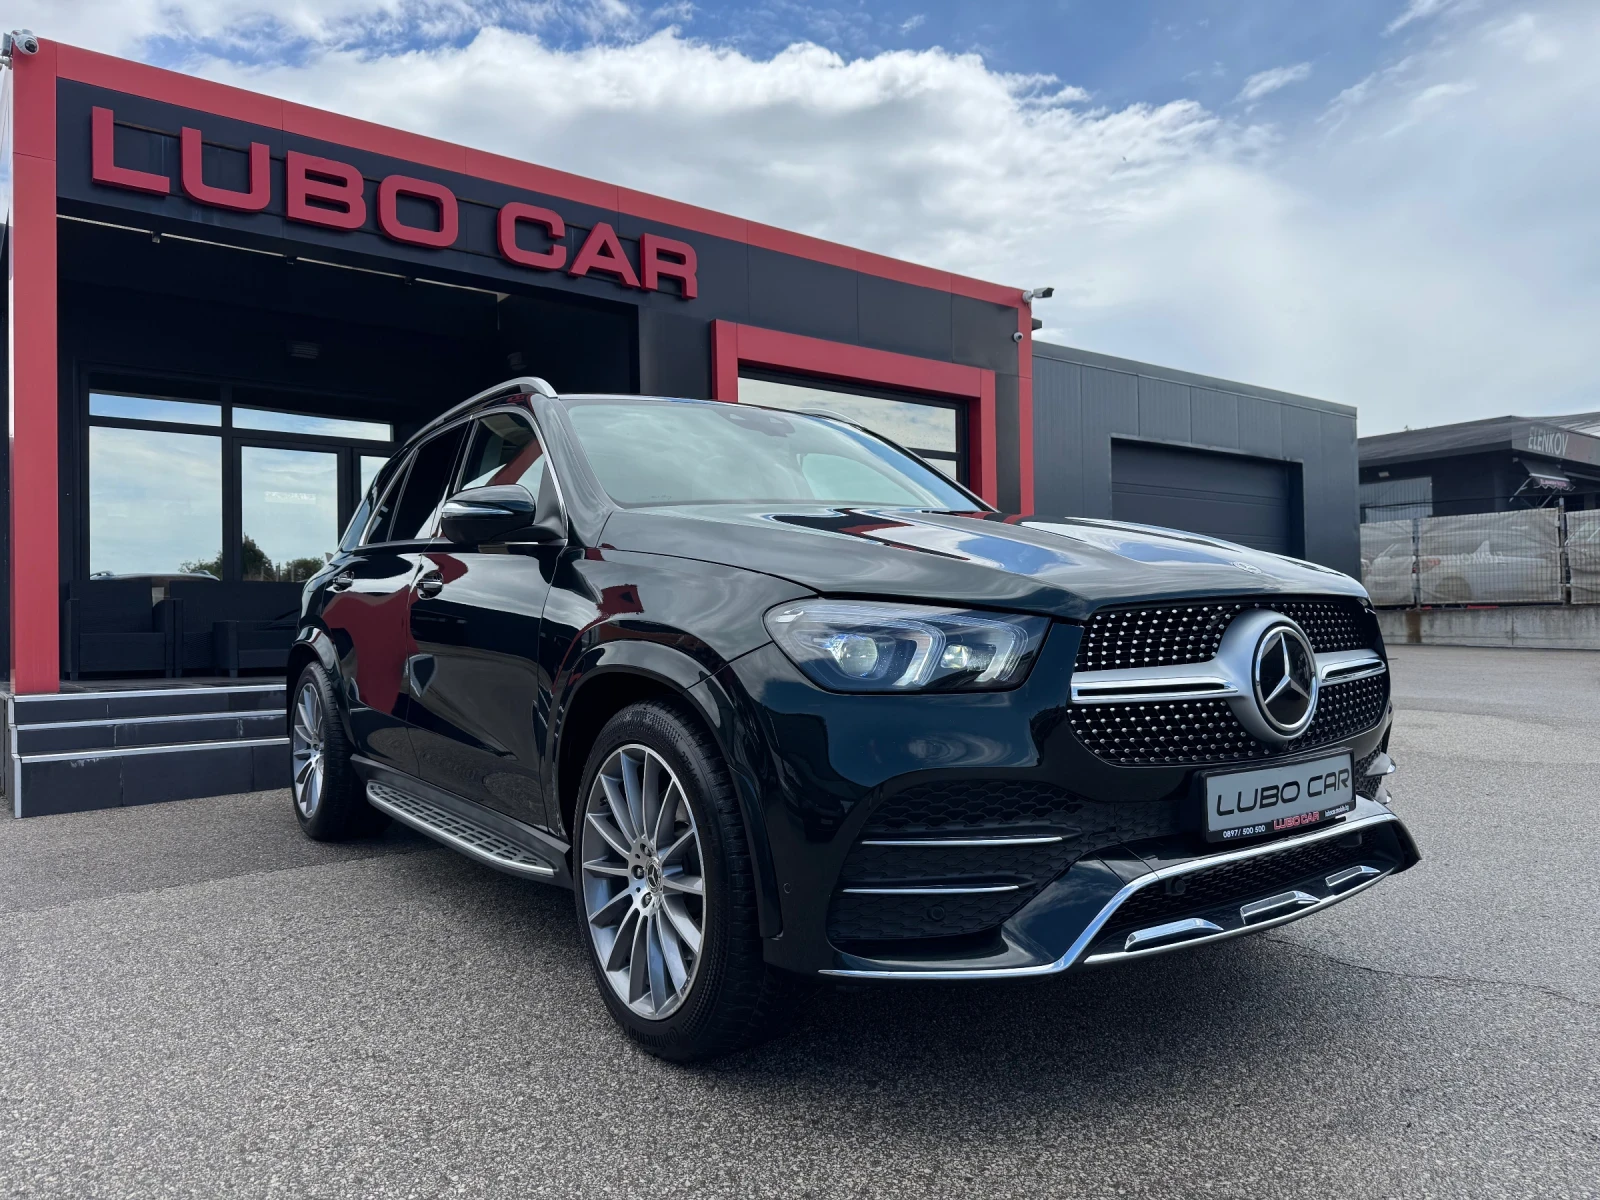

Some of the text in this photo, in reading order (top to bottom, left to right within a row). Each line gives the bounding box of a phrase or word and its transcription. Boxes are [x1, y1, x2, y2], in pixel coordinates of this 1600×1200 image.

[91, 105, 698, 300] LUBO CAR
[1528, 427, 1569, 456] ELENKOV
[1217, 768, 1349, 816] LUBO CAR
[1222, 825, 1266, 838] 0897/ 500 500
[1273, 811, 1319, 829] LUBO CAR
